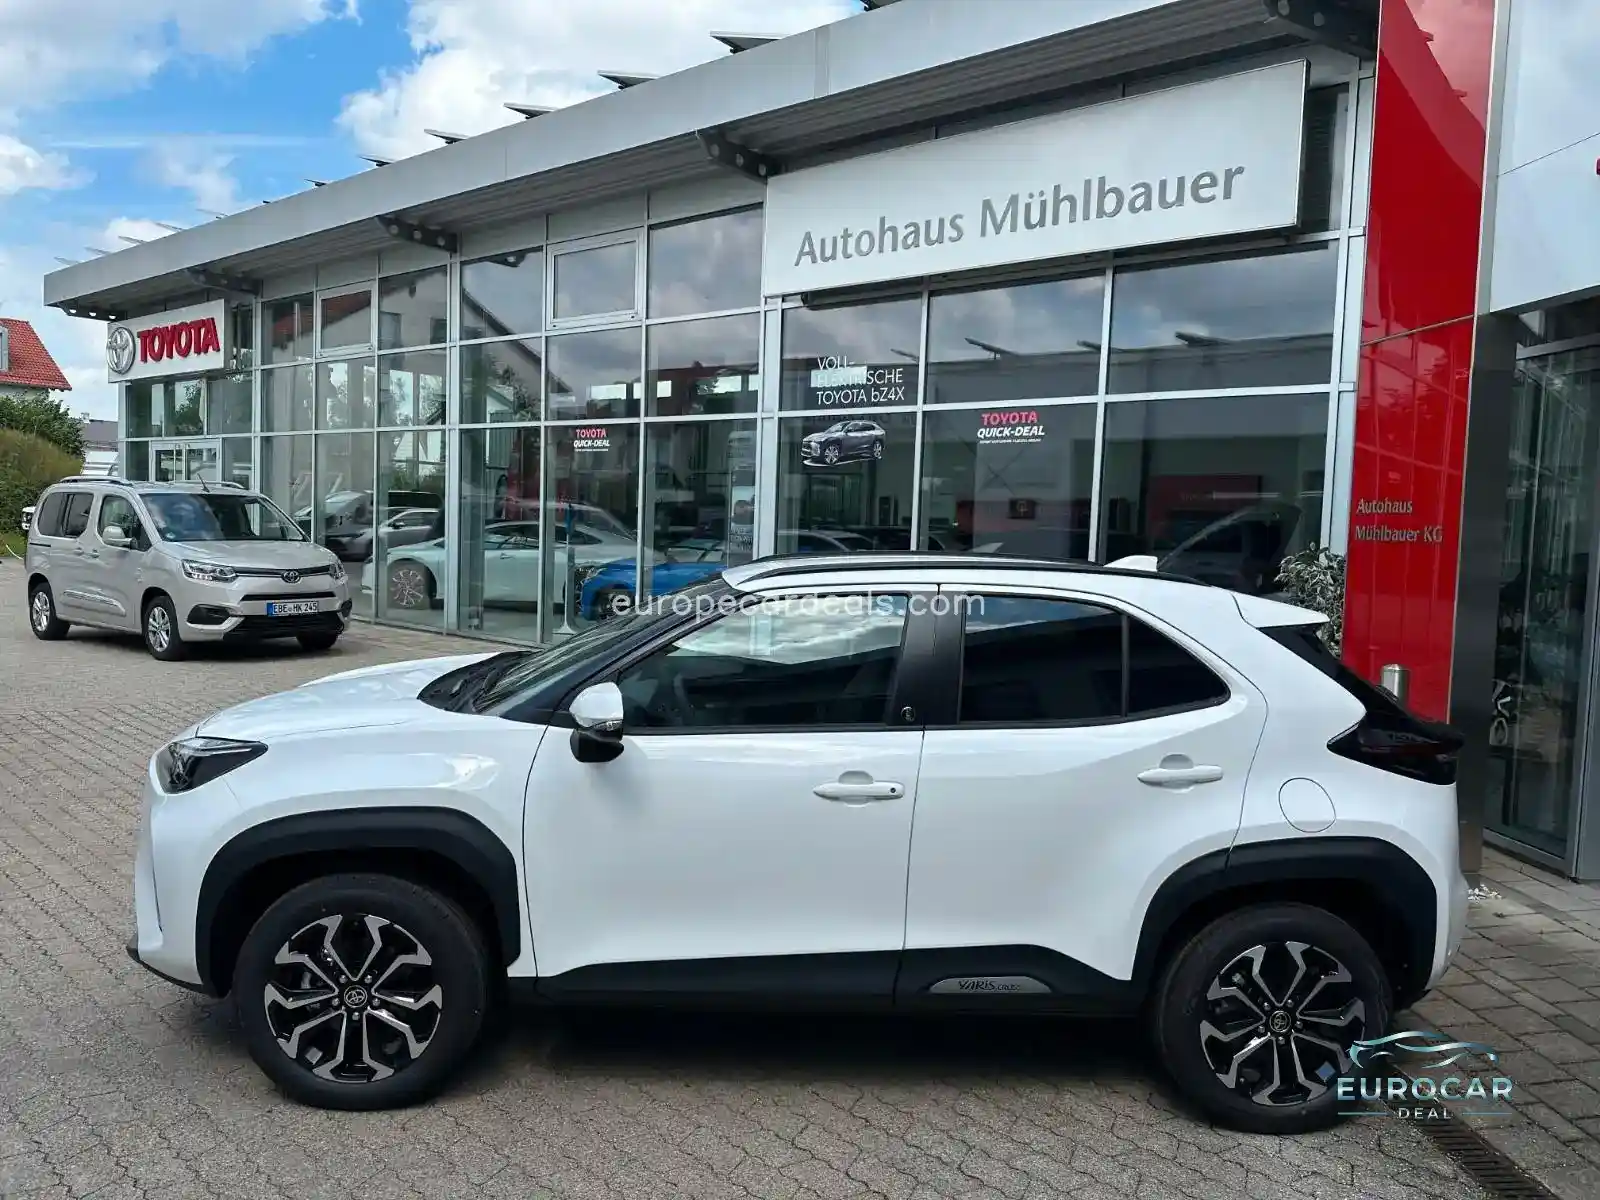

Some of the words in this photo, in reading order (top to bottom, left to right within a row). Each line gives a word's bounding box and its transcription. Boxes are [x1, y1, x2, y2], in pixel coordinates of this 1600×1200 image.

[794, 214, 964, 266] Autohaus
[980, 166, 1244, 238] Mühlbauer
[137, 317, 220, 363] TOYOTA
[817, 355, 856, 370] VOLL-
[816, 388, 867, 405] TOYOTA
[871, 386, 905, 402] bZ4X
[981, 411, 1038, 426] TOYOTA
[575, 428, 607, 439] TOYOTA
[976, 425, 1045, 440] QUICK-DEAL
[573, 439, 611, 449] QUICK-DEAL
[1356, 497, 1413, 514] Autohaus
[1355, 524, 1420, 543] Mühlbauer
[1423, 524, 1443, 543] KG
[958, 979, 997, 991] YARIS
